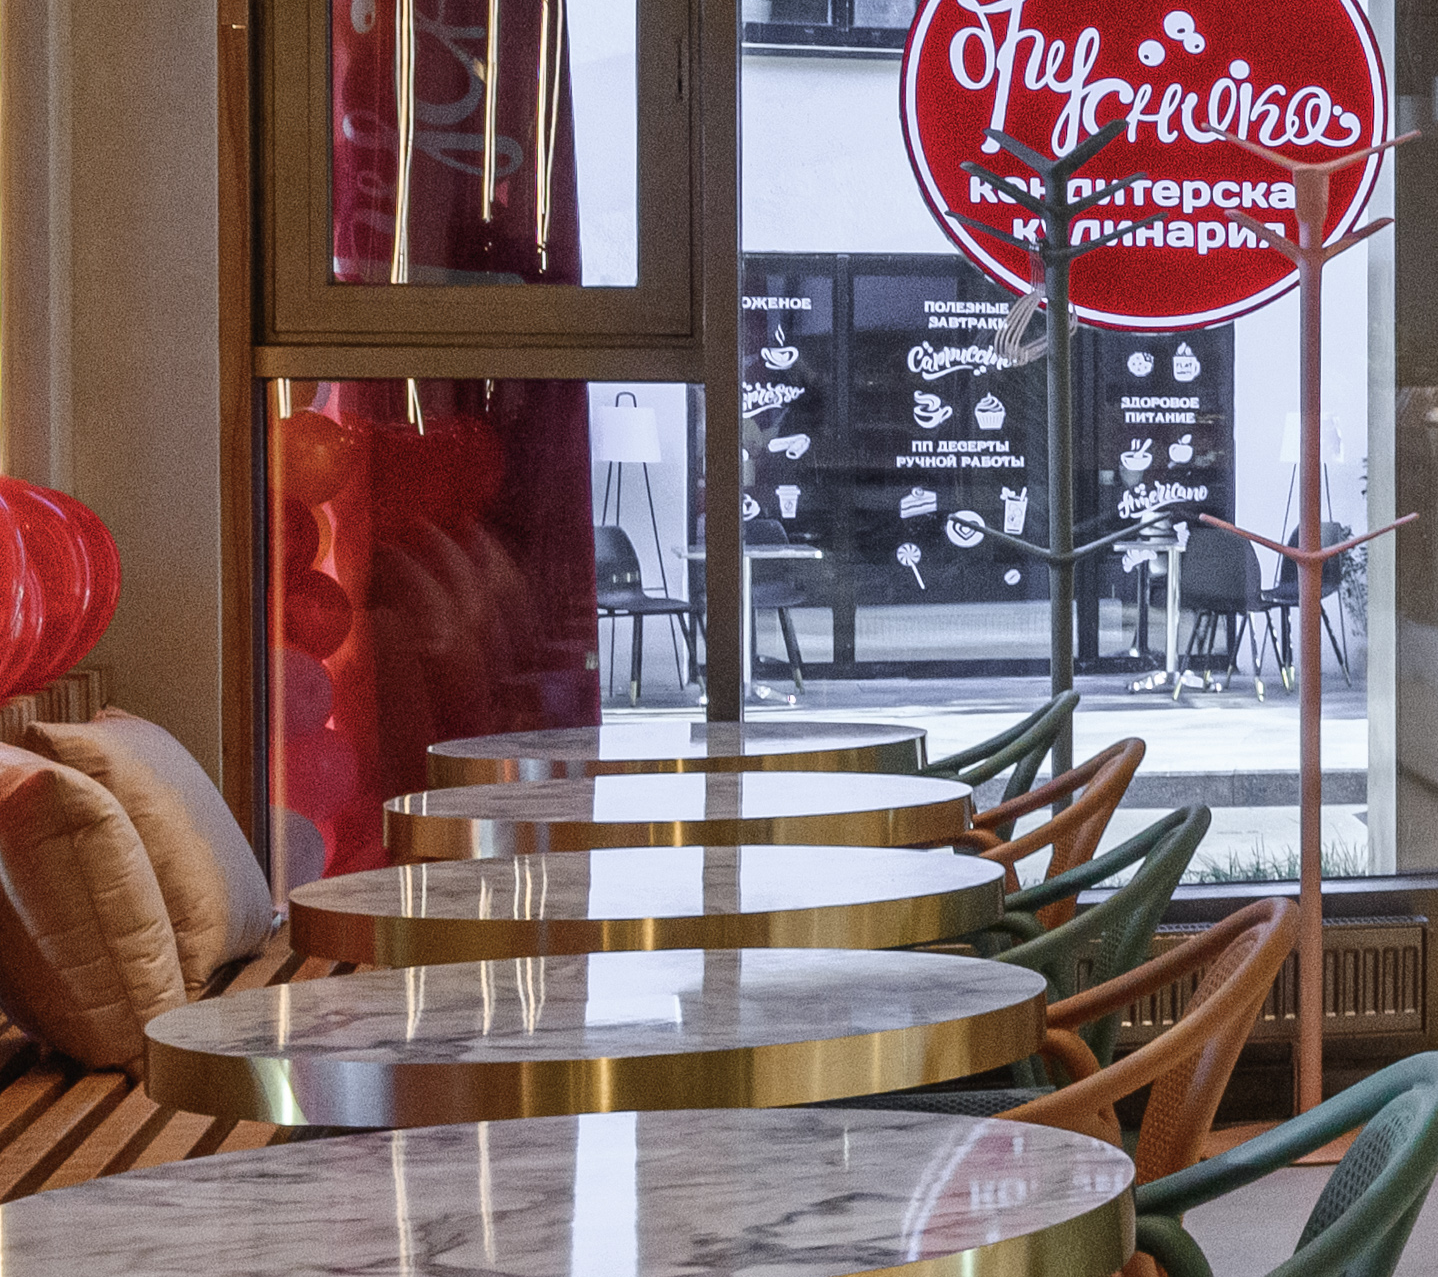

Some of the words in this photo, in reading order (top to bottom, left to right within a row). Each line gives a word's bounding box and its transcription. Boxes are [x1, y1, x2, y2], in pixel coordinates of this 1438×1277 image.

[970, 175, 1296, 213] кондитерска
[742, 297, 811, 310] ОЖЕНОЕ
[924, 301, 1009, 314] ПОЛЕЗНЫЕ
[907, 341, 1012, 380] Cappuccin
[1121, 397, 1200, 409] ЗДОРОВОЕ
[1125, 412, 1196, 423] ПИТАНИЕ
[912, 441, 933, 453] ПП
[937, 441, 1009, 454] ДЕСЕРТЫ
[896, 455, 957, 468] РУЧНОЙ
[961, 456, 1025, 468] РАБОТЫ
[1118, 480, 1208, 519] Americano
